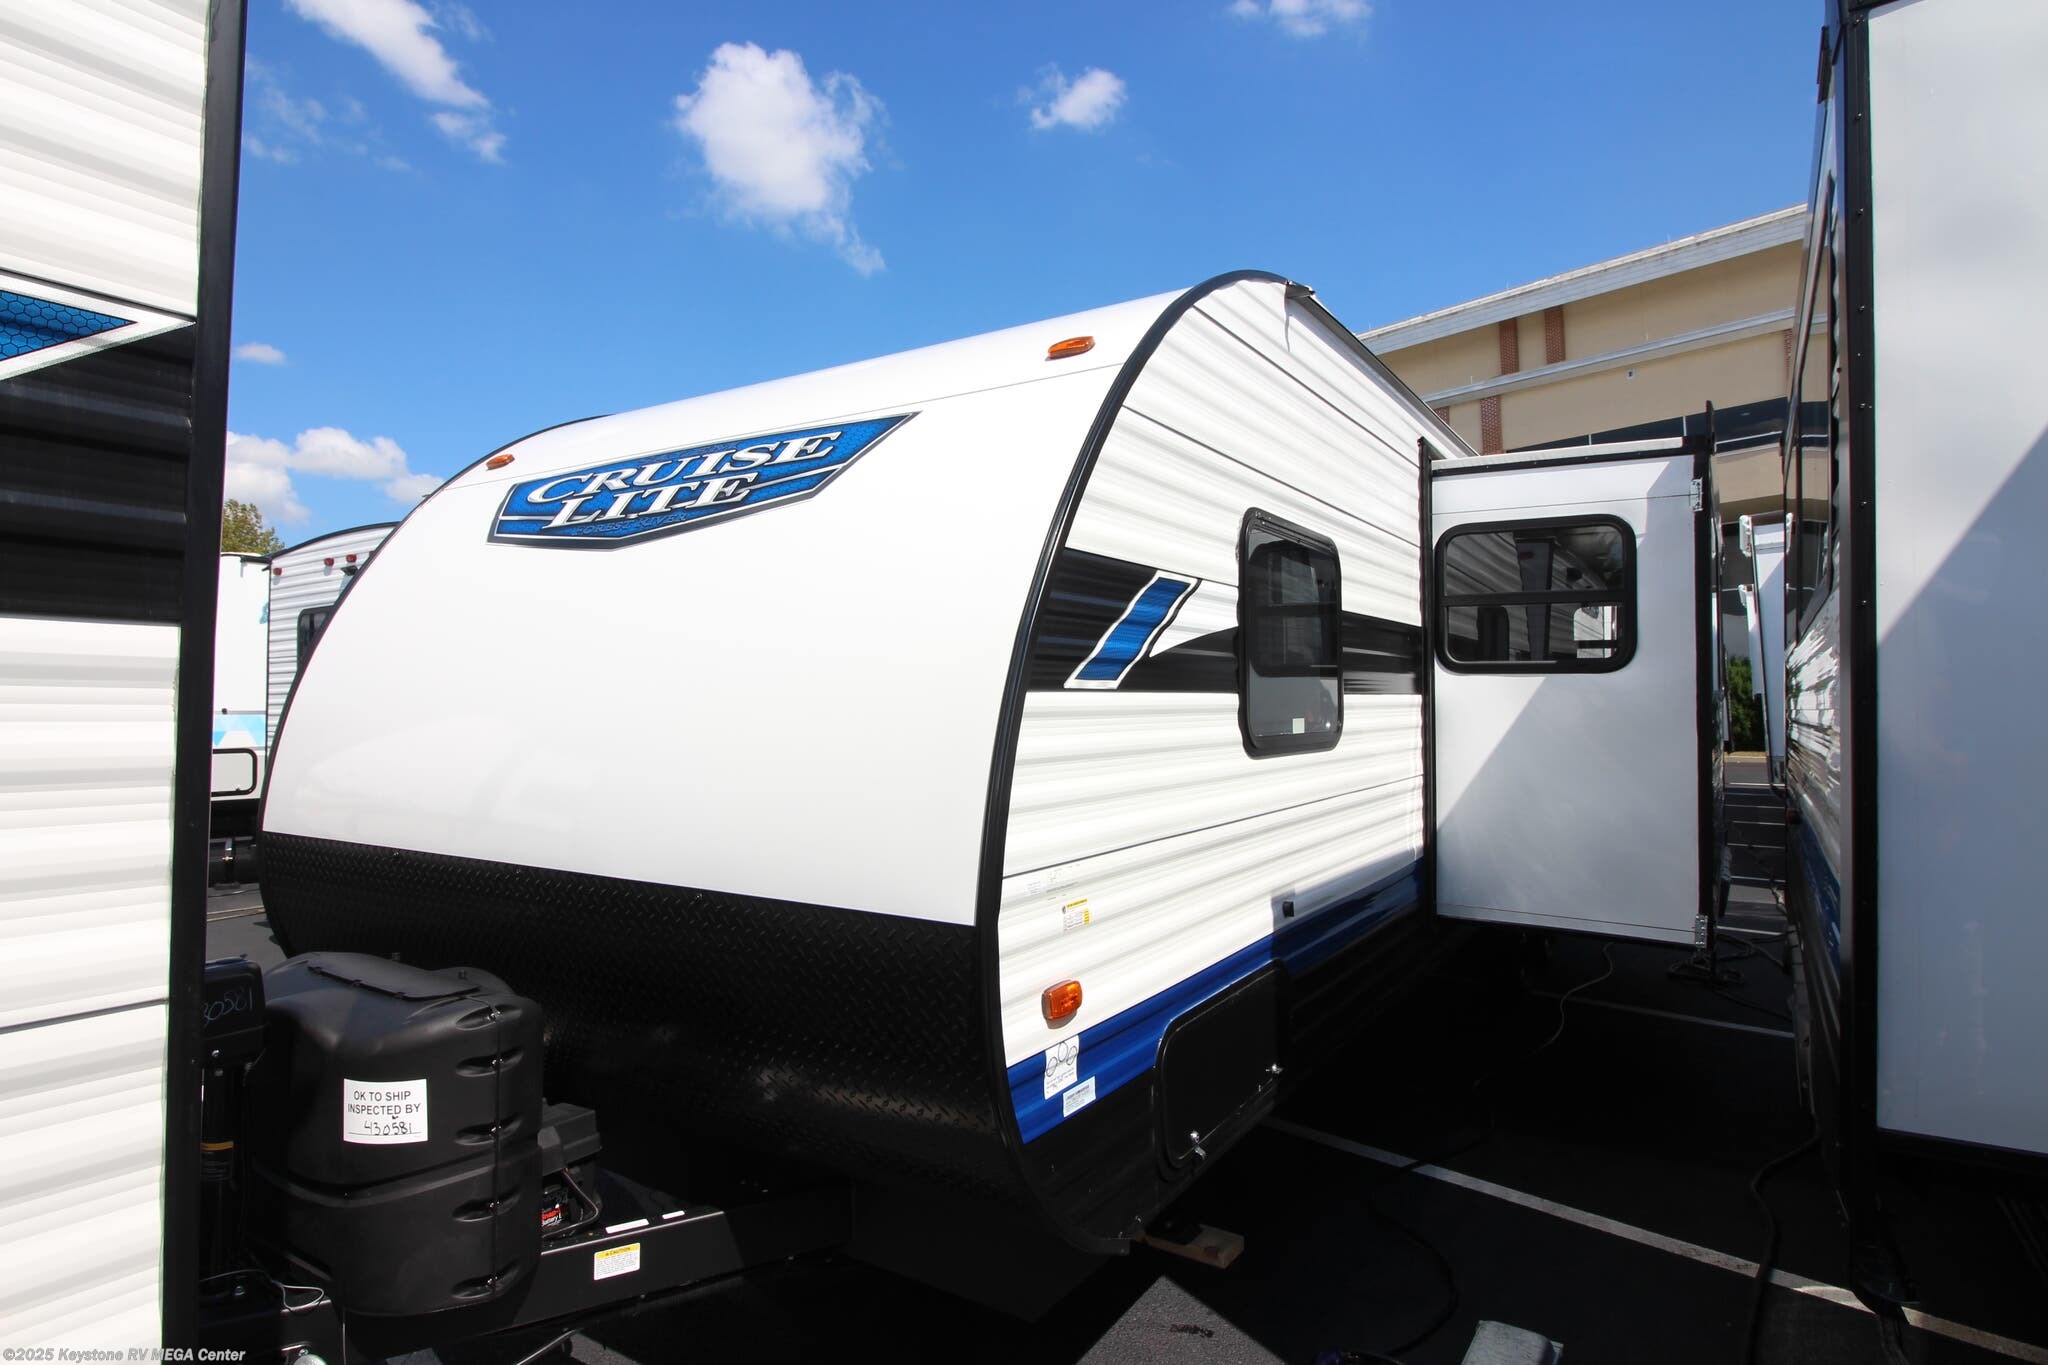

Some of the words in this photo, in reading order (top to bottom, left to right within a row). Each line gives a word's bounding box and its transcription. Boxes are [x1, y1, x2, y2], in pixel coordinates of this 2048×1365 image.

[526, 431, 843, 505] CRUISE
[541, 472, 759, 530] LITE
[573, 518, 636, 536] FOREST
[353, 1090, 367, 1101] OK
[369, 1091, 382, 1102] TO
[385, 1090, 411, 1101] SHIP
[347, 1103, 402, 1115] INSPECTED
[405, 1103, 421, 1114] BY
[364, 1116, 412, 1136] 430581
